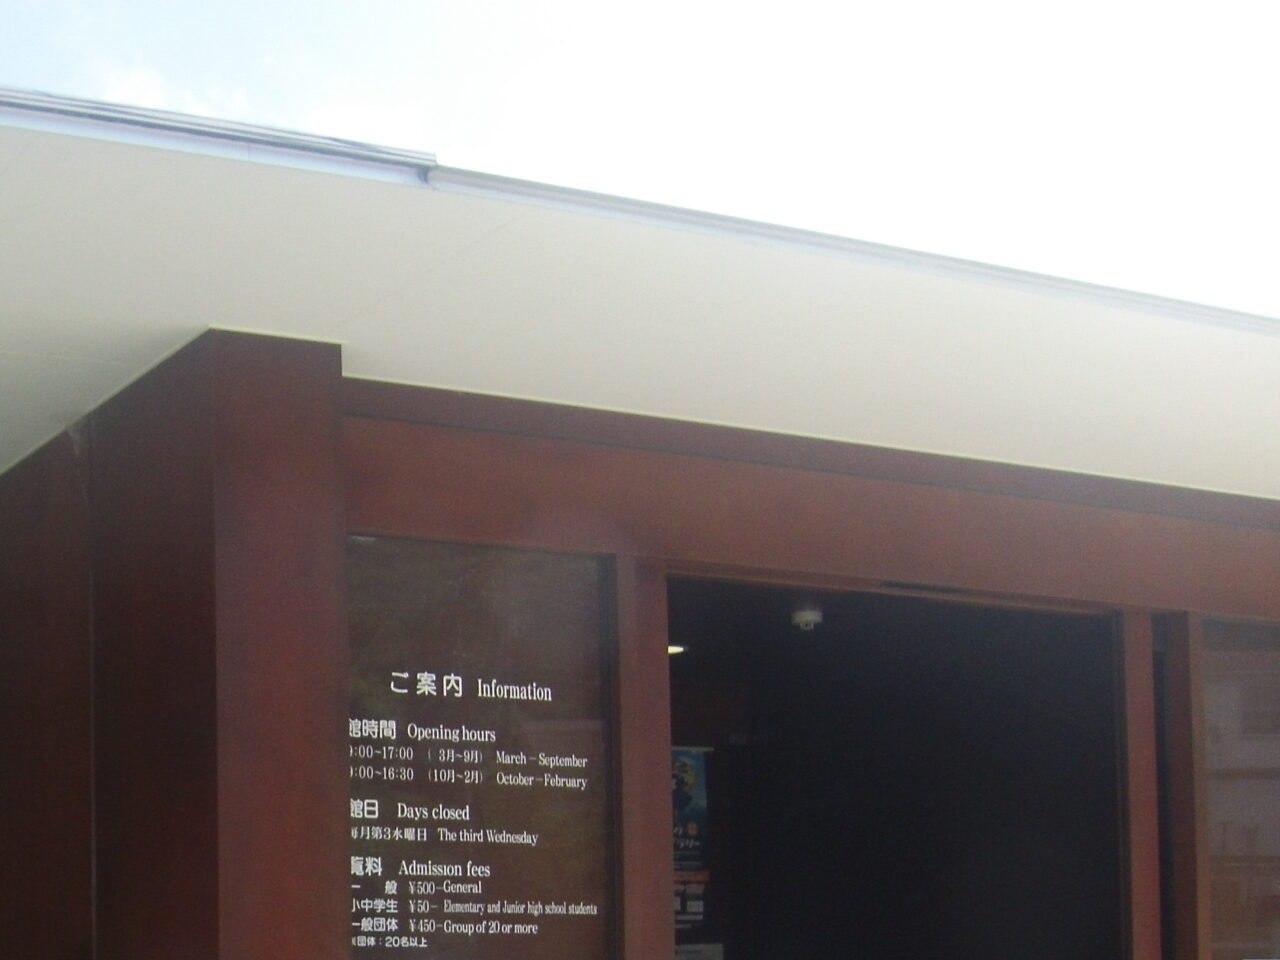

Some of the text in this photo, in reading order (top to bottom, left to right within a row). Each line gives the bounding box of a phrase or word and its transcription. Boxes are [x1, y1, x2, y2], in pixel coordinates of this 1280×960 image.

[390, 671, 552, 701] ご案内 Information
[407, 723, 460, 742] Opening
[462, 725, 496, 742] hours
[496, 751, 527, 765] March
[538, 752, 588, 769] September
[496, 771, 534, 786] October
[544, 773, 588, 791] February
[397, 802, 429, 820] Days
[432, 804, 470, 820] closed
[438, 828, 457, 842] The
[459, 828, 484, 843] third
[486, 829, 538, 846] Wednesday
[398, 860, 462, 877] Admission
[466, 861, 491, 878] fees
[443, 880, 482, 894] General
[443, 899, 485, 916] Elementary
[487, 901, 501, 915] and
[502, 901, 526, 915] Junior
[527, 902, 544, 917] high
[544, 902, 567, 916] school
[568, 902, 598, 916] students
[443, 919, 475, 936] Group
[475, 921, 487, 934] of
[488, 920, 500, 935] 20
[501, 923, 513, 935] or
[514, 923, 539, 936] more
